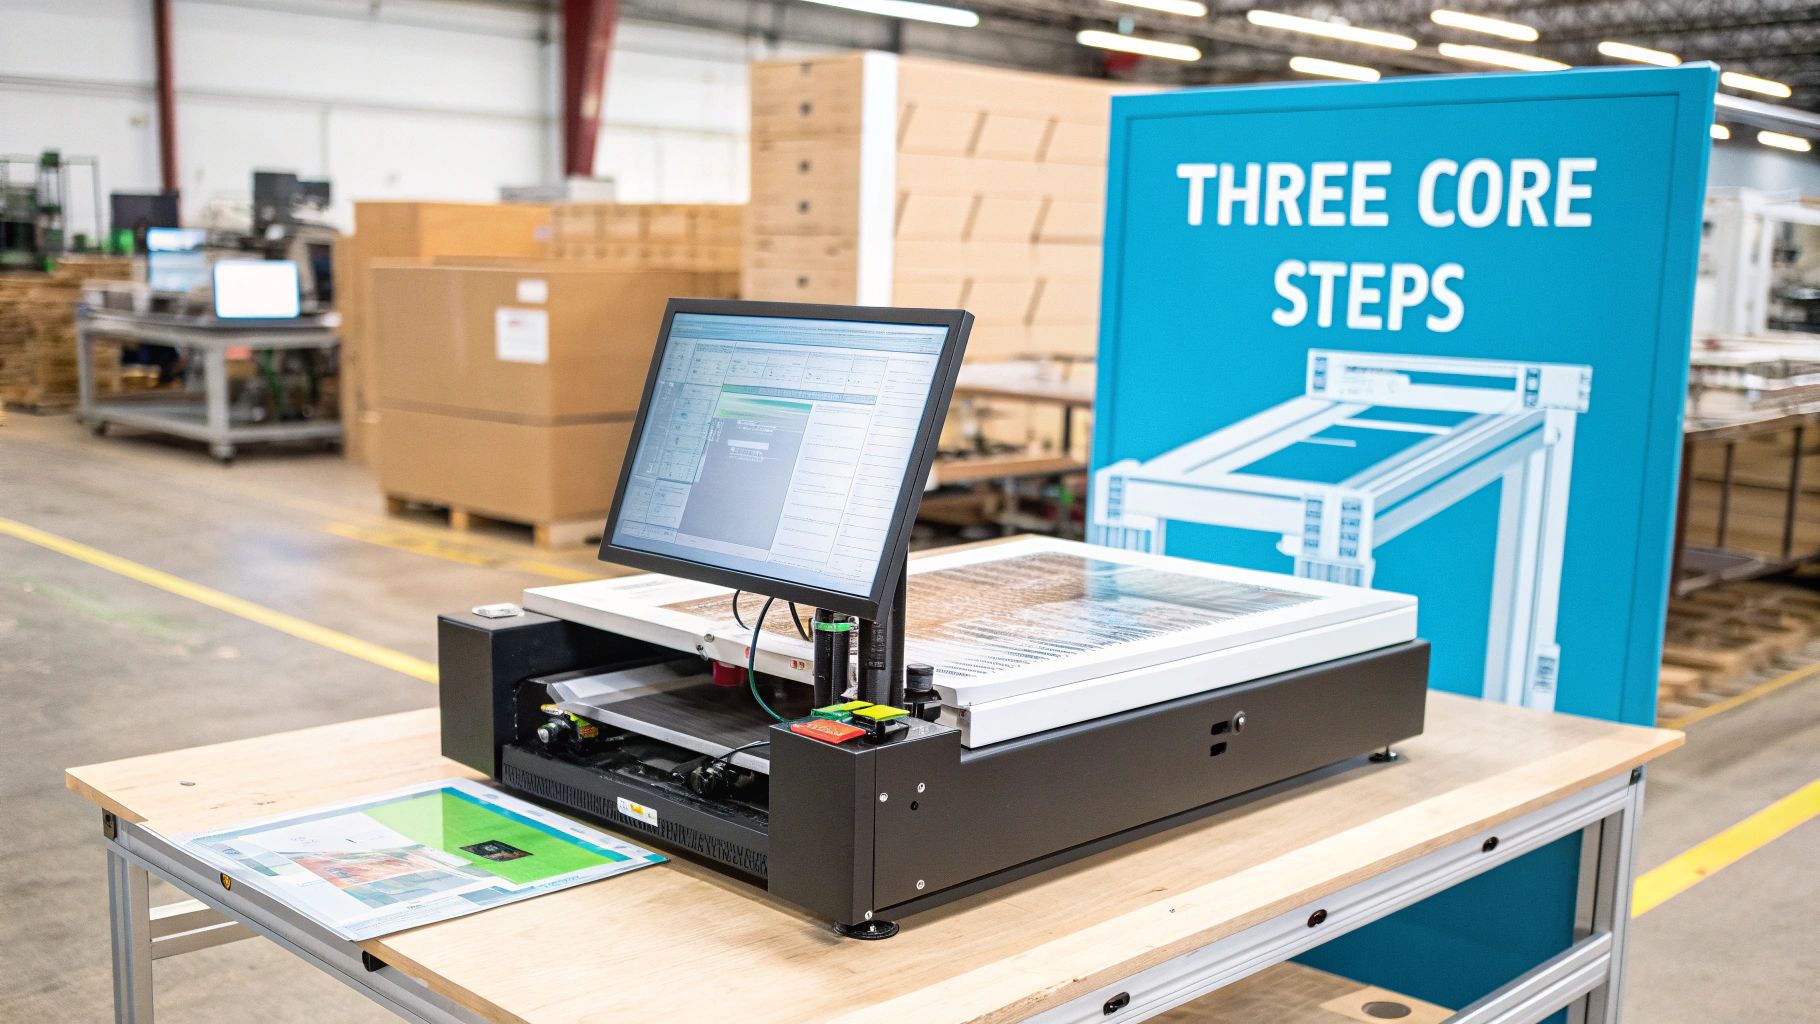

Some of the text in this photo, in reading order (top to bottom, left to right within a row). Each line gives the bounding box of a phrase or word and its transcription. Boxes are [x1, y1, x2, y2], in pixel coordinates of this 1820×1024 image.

[1176, 157, 1598, 228] THREE CORE
[1272, 260, 1465, 333] STEPS
